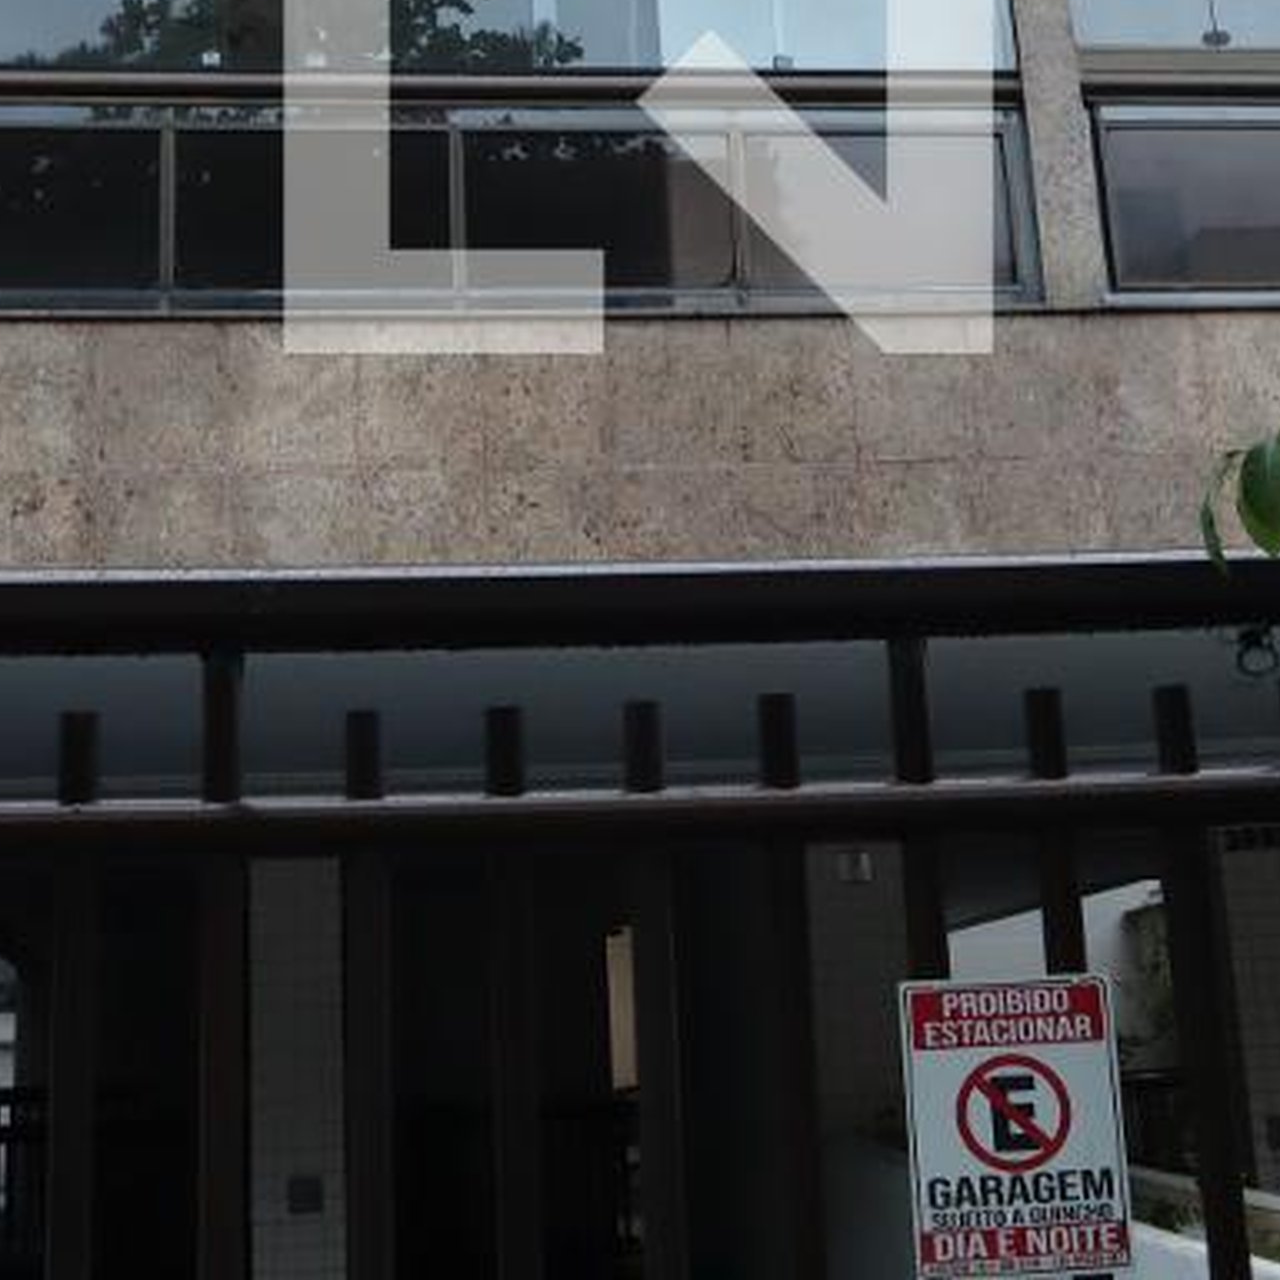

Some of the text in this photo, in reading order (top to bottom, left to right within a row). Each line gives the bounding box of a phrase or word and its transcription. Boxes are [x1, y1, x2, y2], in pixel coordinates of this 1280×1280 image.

[941, 987, 1070, 1018] PROIBIDO
[923, 1013, 1093, 1049] ESTACIONAR
[927, 1167, 1115, 1211] GARAGEM
[932, 1222, 1120, 1263] DIA E NOITE
